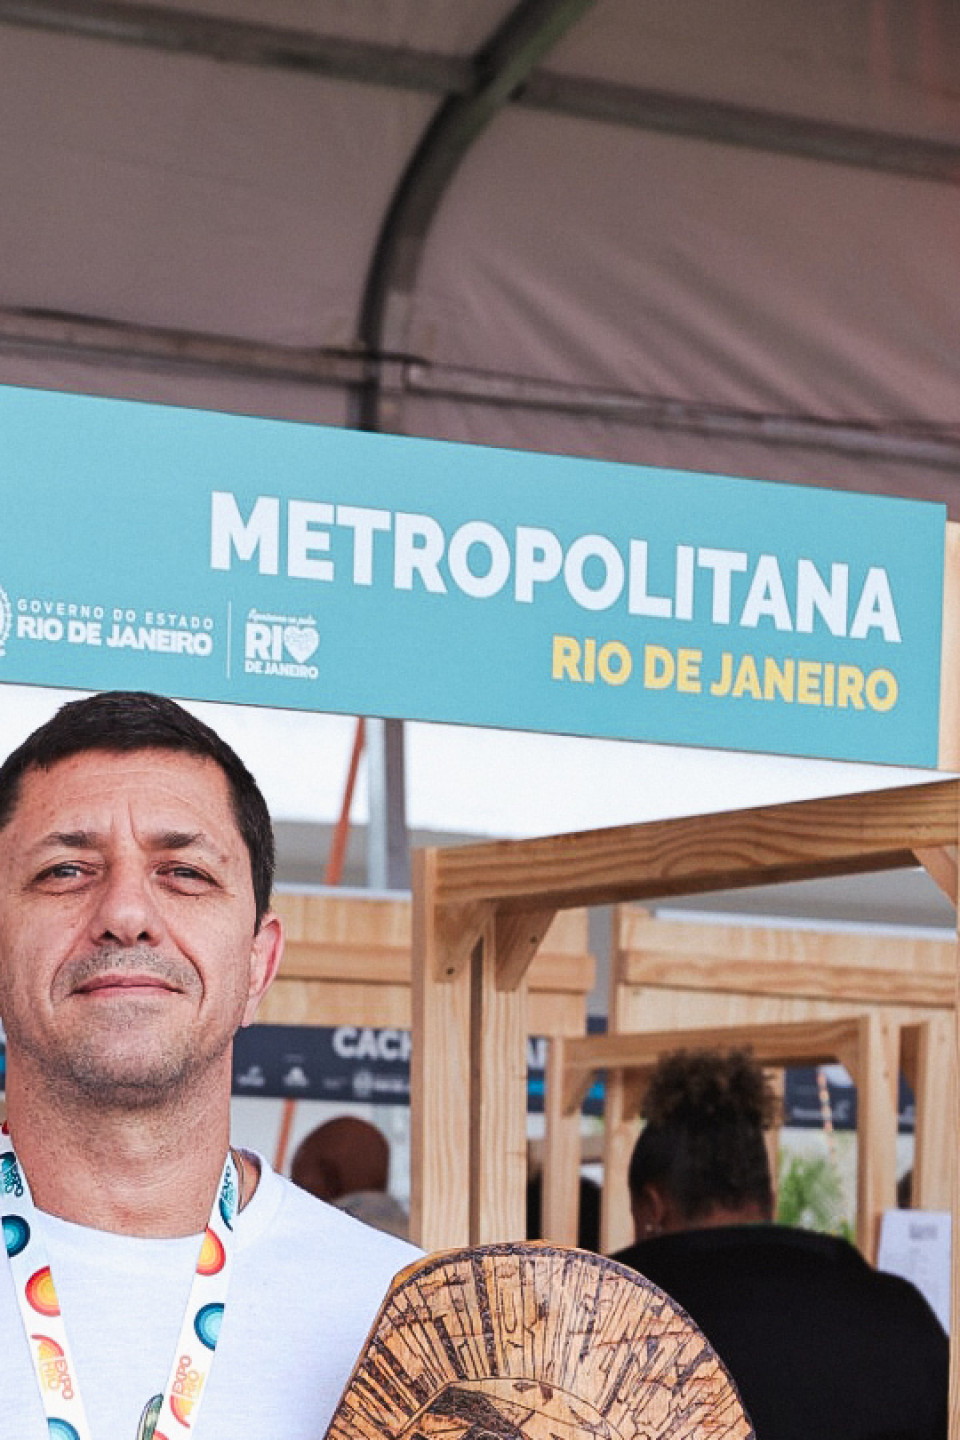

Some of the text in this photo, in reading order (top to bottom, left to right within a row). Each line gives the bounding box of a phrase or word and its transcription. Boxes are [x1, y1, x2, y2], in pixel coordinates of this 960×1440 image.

[209, 491, 902, 643] METROPOLITANA
[17, 598, 214, 631] GOVERNO DO ESTADO
[17, 615, 213, 657] RIO DE JANEIRO
[244, 659, 319, 680] DE JANEIRO
[551, 634, 899, 712] RIO DE JANEIRO
